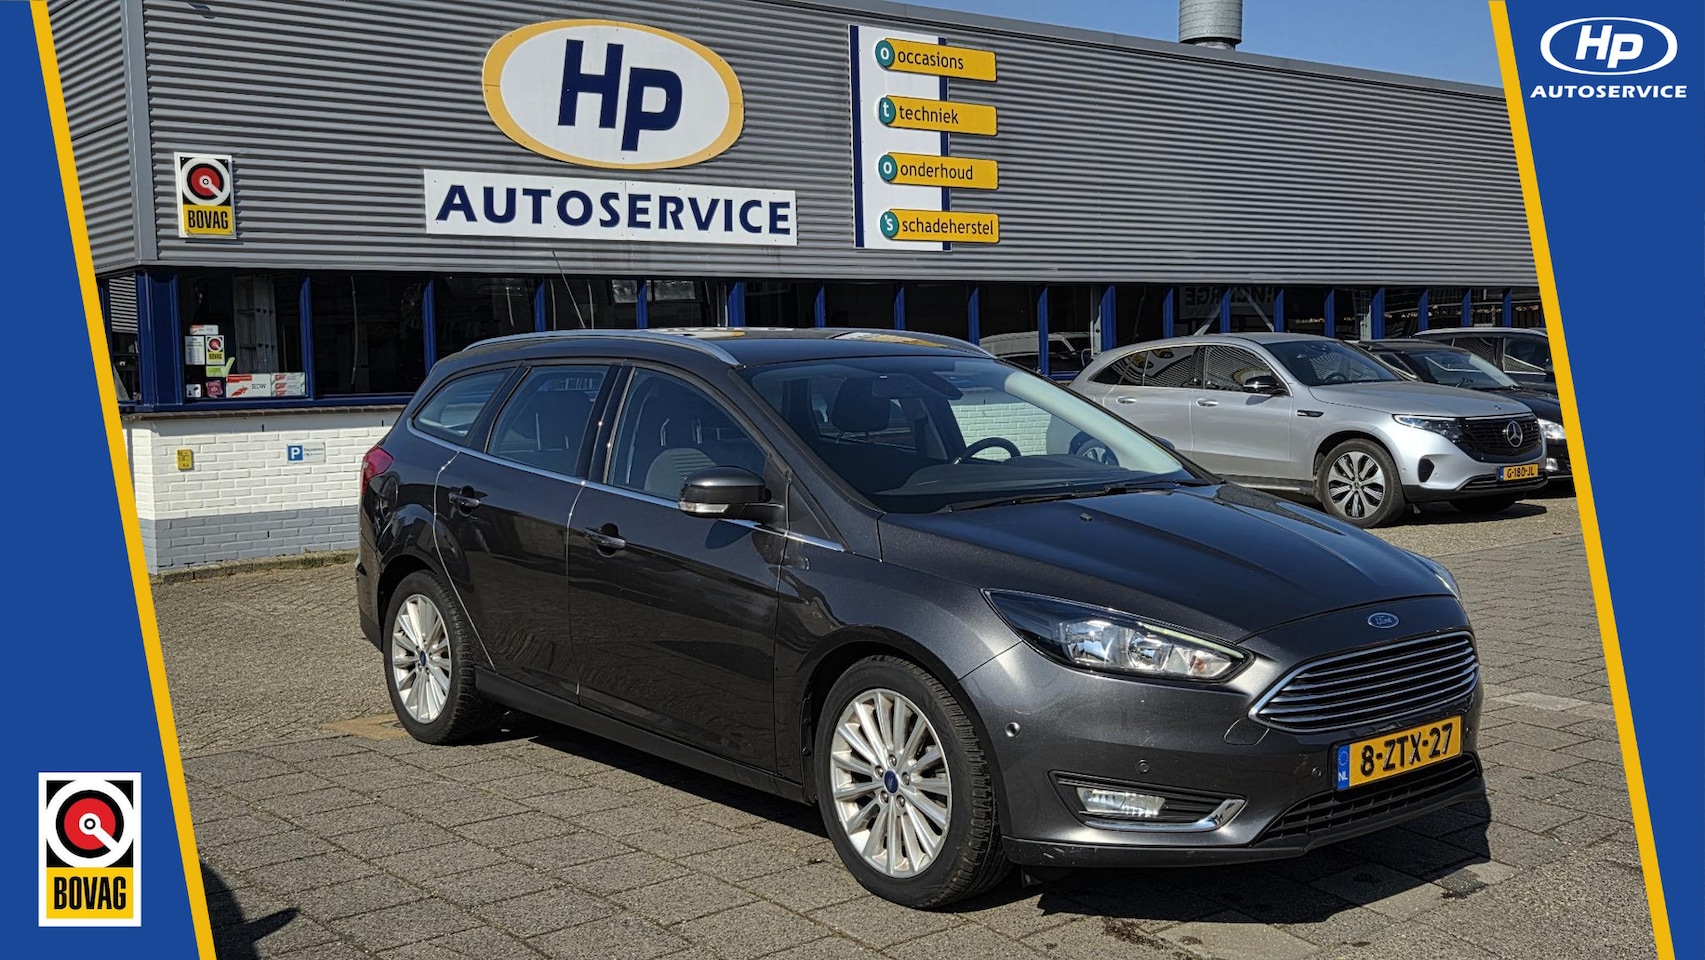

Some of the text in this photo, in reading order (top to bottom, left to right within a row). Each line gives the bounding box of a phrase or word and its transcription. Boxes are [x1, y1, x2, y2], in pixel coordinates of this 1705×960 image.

[897, 50, 964, 70] occasions
[899, 106, 959, 124] techniek
[900, 162, 973, 180] onderhoud
[435, 184, 791, 235] AUTOSERVICE
[188, 210, 228, 229] BOVAG
[902, 217, 994, 235] schadeherstel
[1360, 722, 1453, 777] 8-ZTX-27
[1338, 771, 1348, 782] NL
